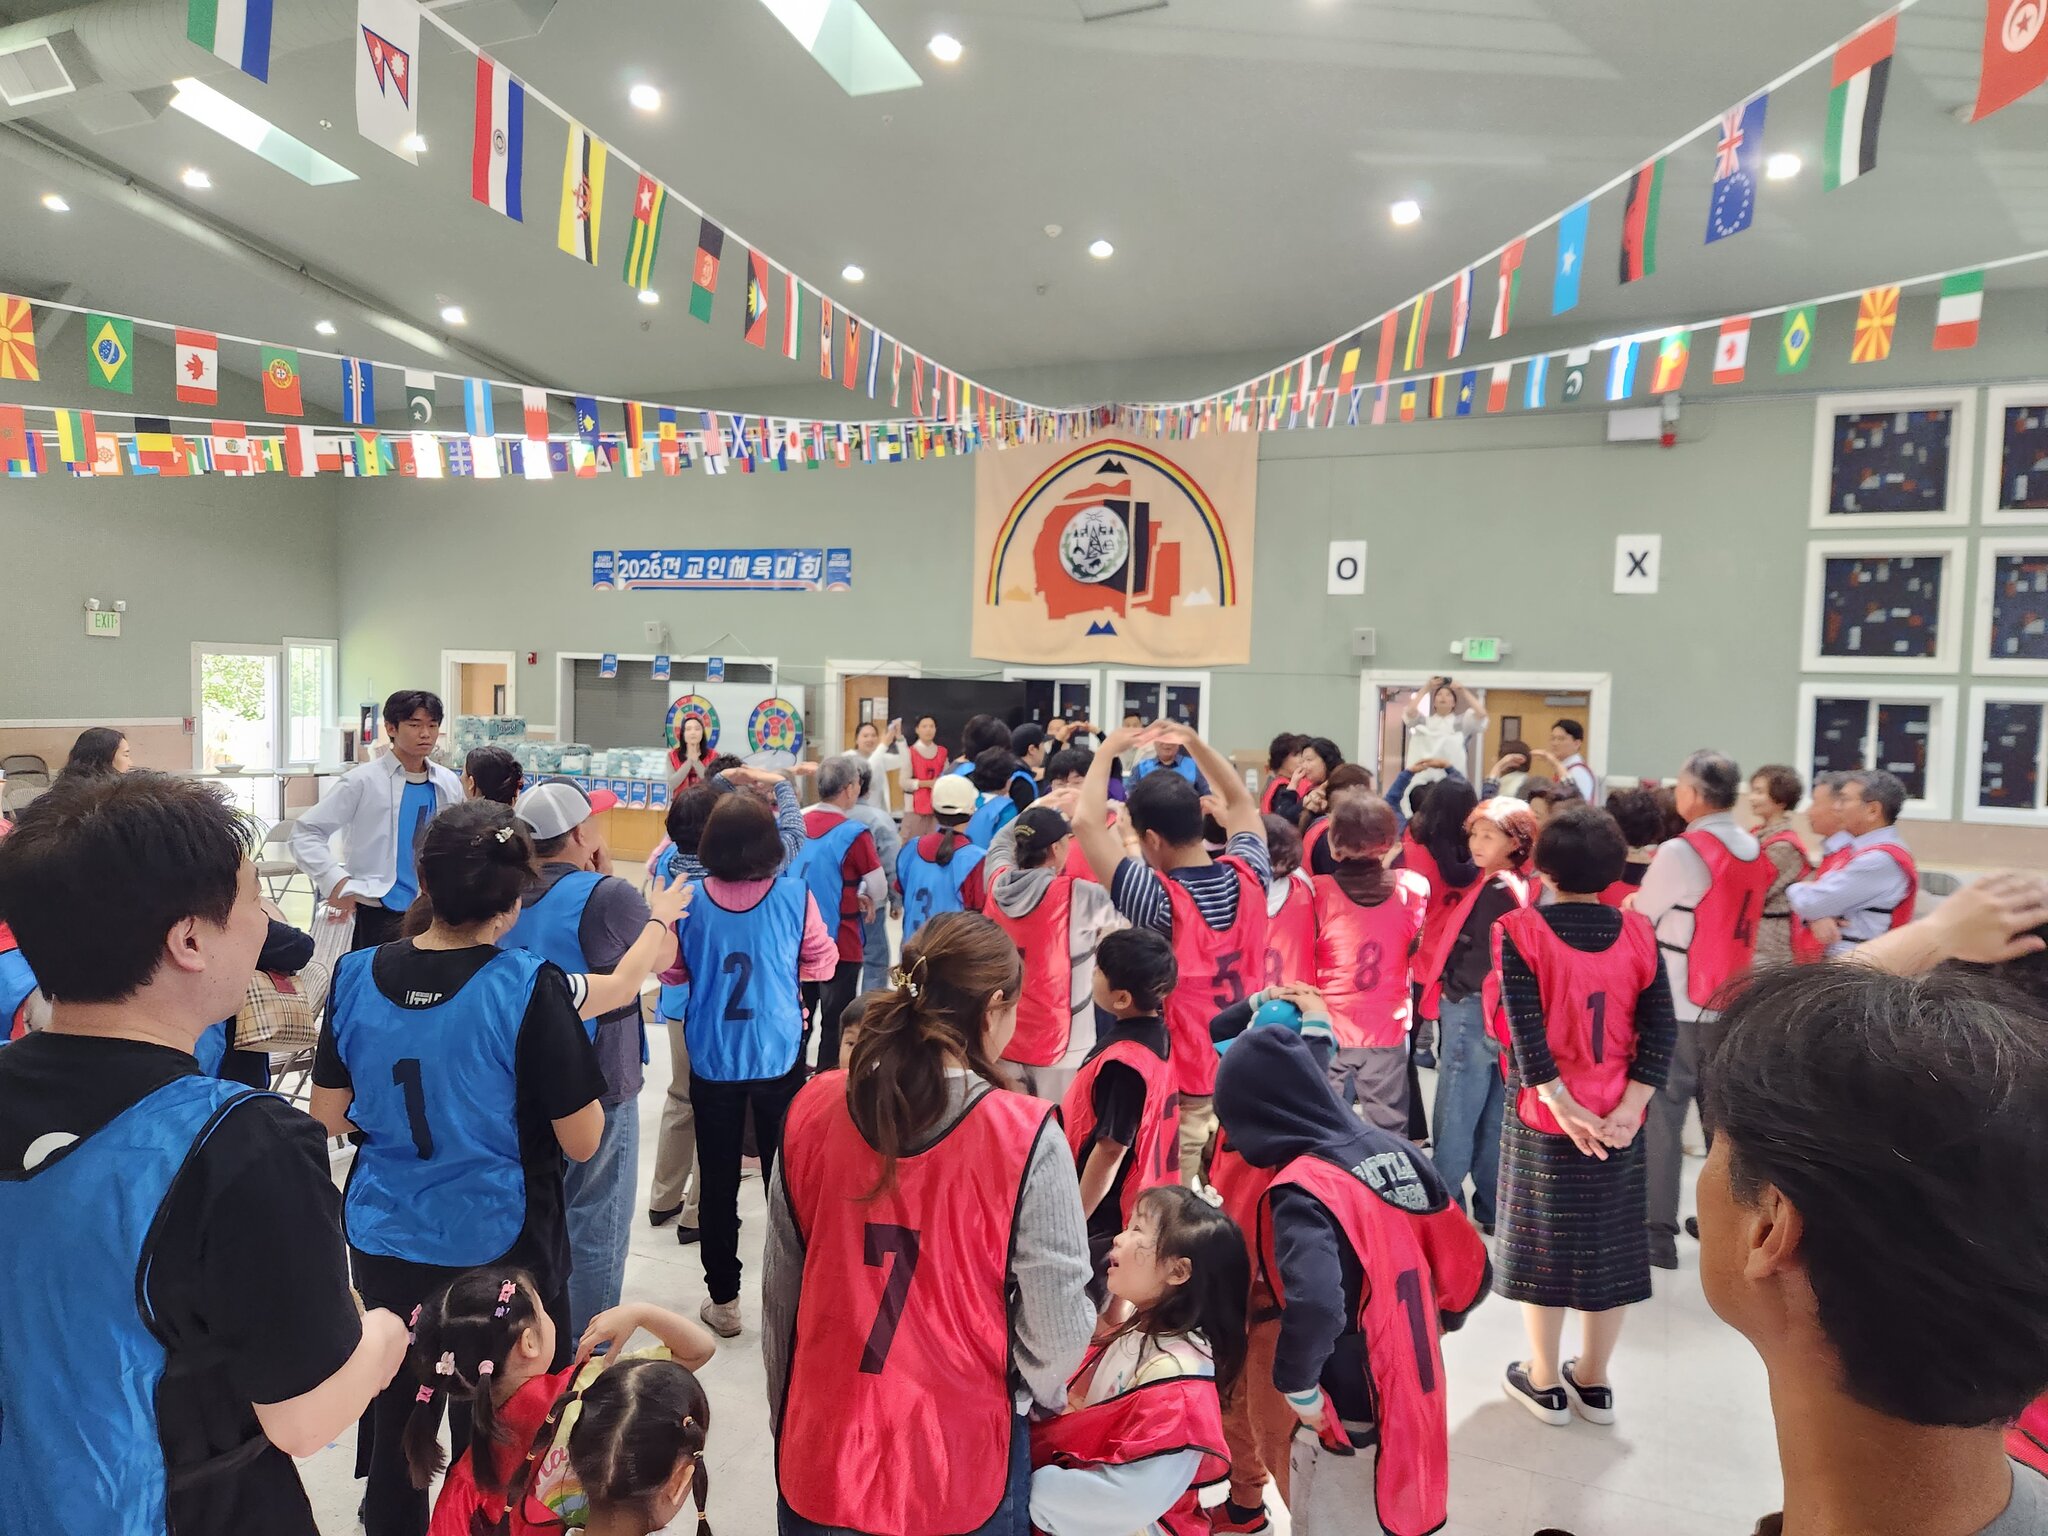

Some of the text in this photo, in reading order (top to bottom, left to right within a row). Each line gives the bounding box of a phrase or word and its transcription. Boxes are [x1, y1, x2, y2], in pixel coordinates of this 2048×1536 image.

[1337, 557, 1358, 580] O
[1627, 551, 1649, 577] X
[95, 613, 116, 628] EXIT
[913, 887, 933, 930] 3
[1734, 889, 1754, 946] 4
[723, 952, 754, 1021] 2
[1211, 949, 1245, 1011] 5
[1355, 941, 1381, 991] 8
[1586, 991, 1607, 1064] 1
[391, 1057, 435, 1160] 1
[858, 1222, 921, 1375] 7
[1396, 1268, 1435, 1395] 1
